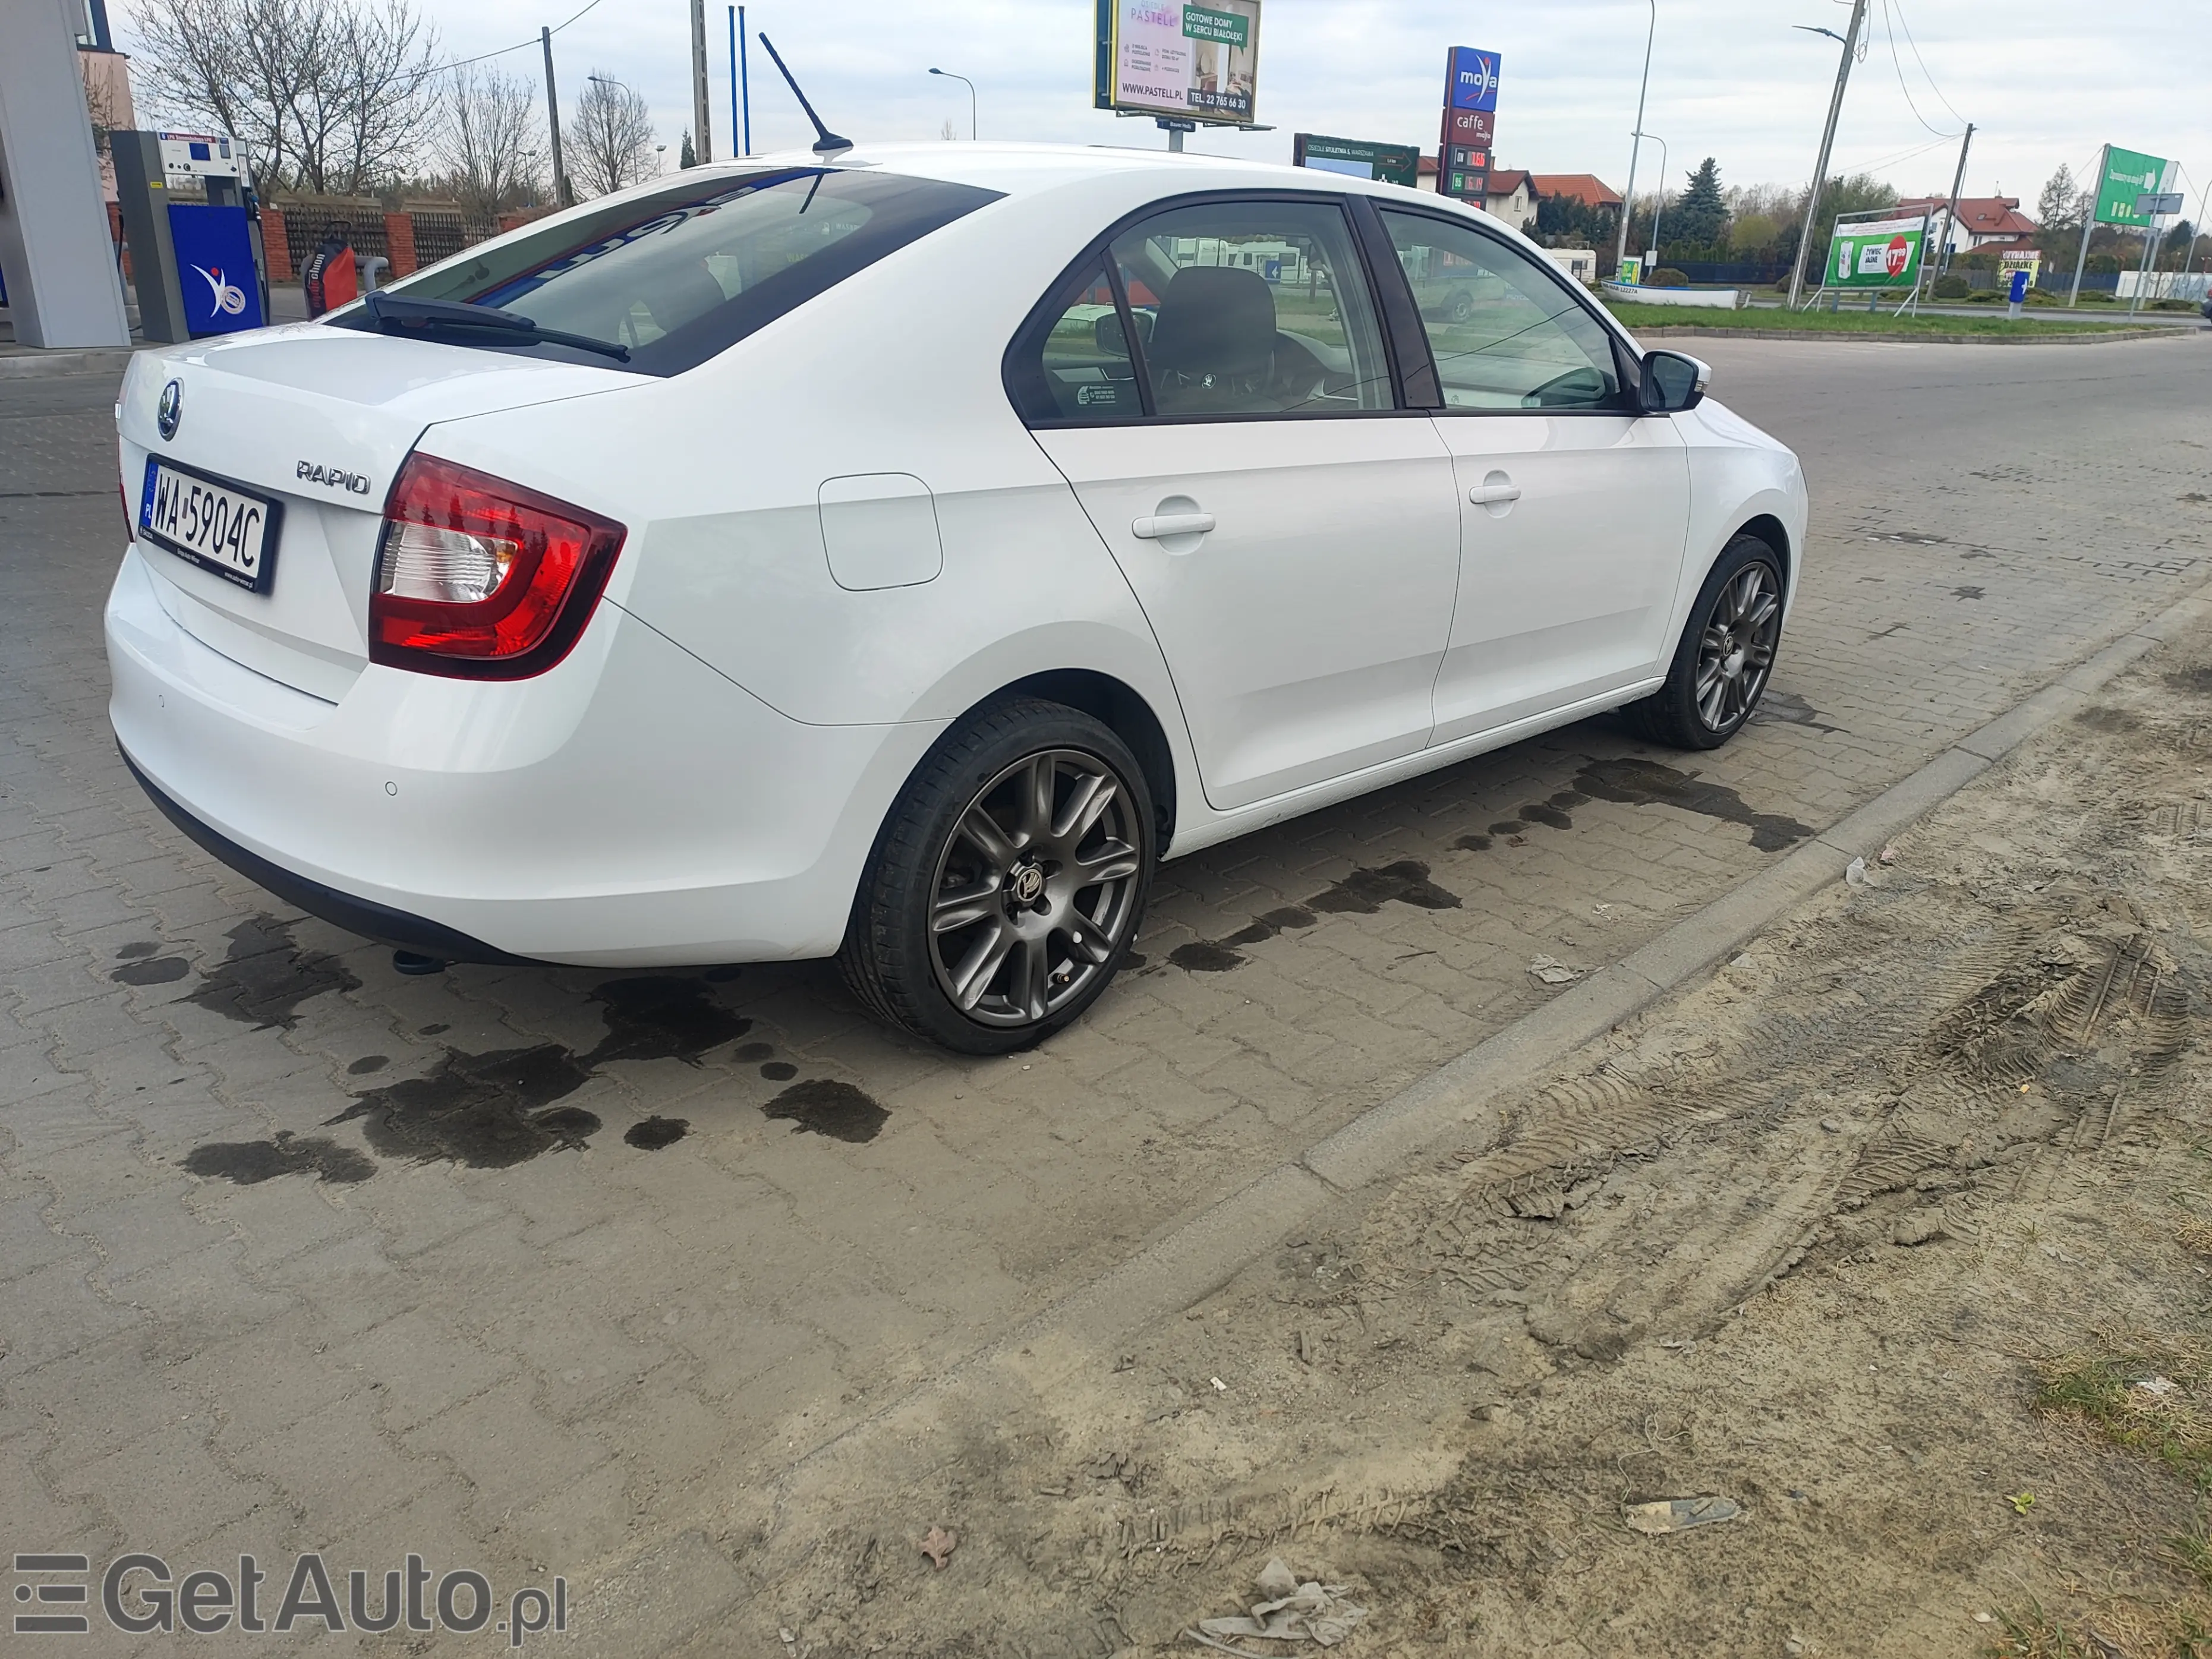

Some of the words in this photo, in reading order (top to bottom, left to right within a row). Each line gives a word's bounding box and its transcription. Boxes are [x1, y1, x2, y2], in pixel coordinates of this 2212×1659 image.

[1131, 8, 1174, 27] PASTELL
[1186, 12, 1214, 26] GOTOWE
[1214, 18, 1233, 29] DOMY
[1186, 23, 1192, 33] W
[1193, 24, 1213, 36] SERCU
[1213, 29, 1243, 42] BIAŁOŁĘKI
[1122, 82, 1183, 100] WWW.PASTELL.PL
[1191, 92, 1205, 103] TEL.
[1206, 94, 1215, 105] 22
[1216, 96, 1227, 106] 765
[1228, 97, 1237, 108] 66
[1238, 99, 1246, 109] 30
[1457, 115, 1483, 130] caffe
[297, 460, 371, 495] RAPID
[145, 503, 152, 519] PL
[155, 473, 179, 536] WA
[185, 485, 260, 568] 5904C
